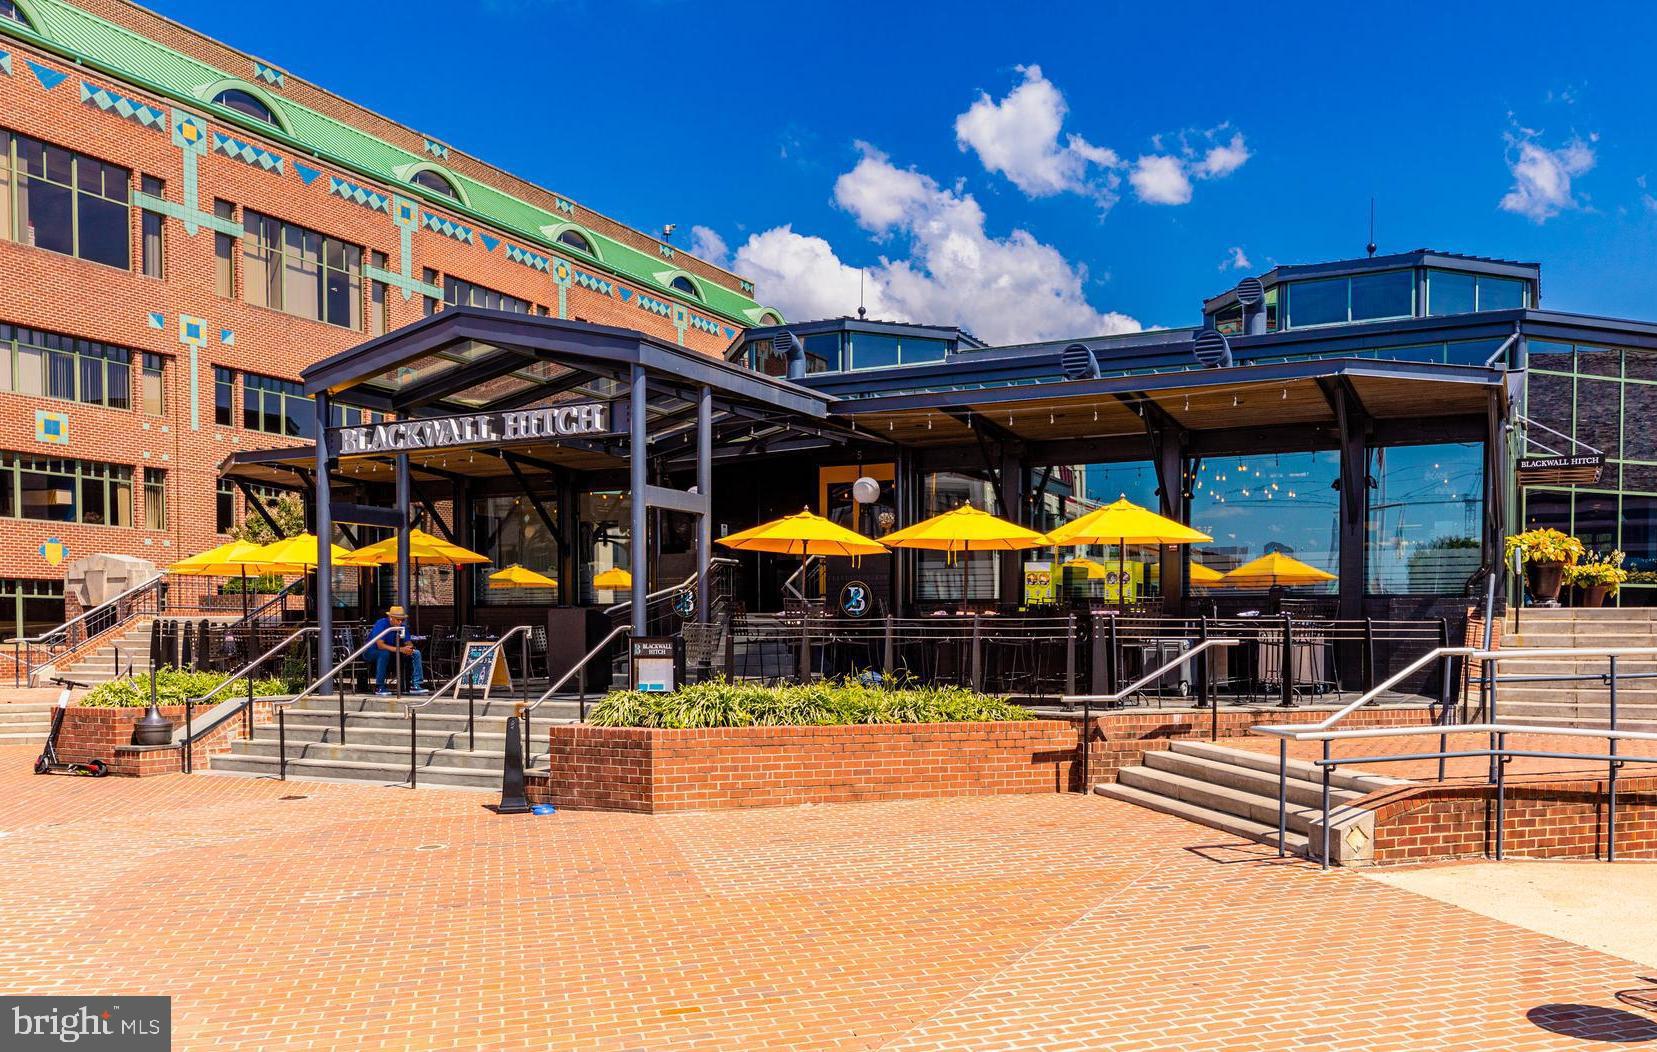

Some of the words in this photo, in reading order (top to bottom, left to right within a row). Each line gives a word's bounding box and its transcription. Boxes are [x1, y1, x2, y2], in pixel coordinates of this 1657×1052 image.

[339, 415, 499, 453] BLACKWALL
[502, 403, 608, 440] HITCH
[1521, 458, 1569, 468] BLACKWALL
[1571, 456, 1600, 465] HITCH
